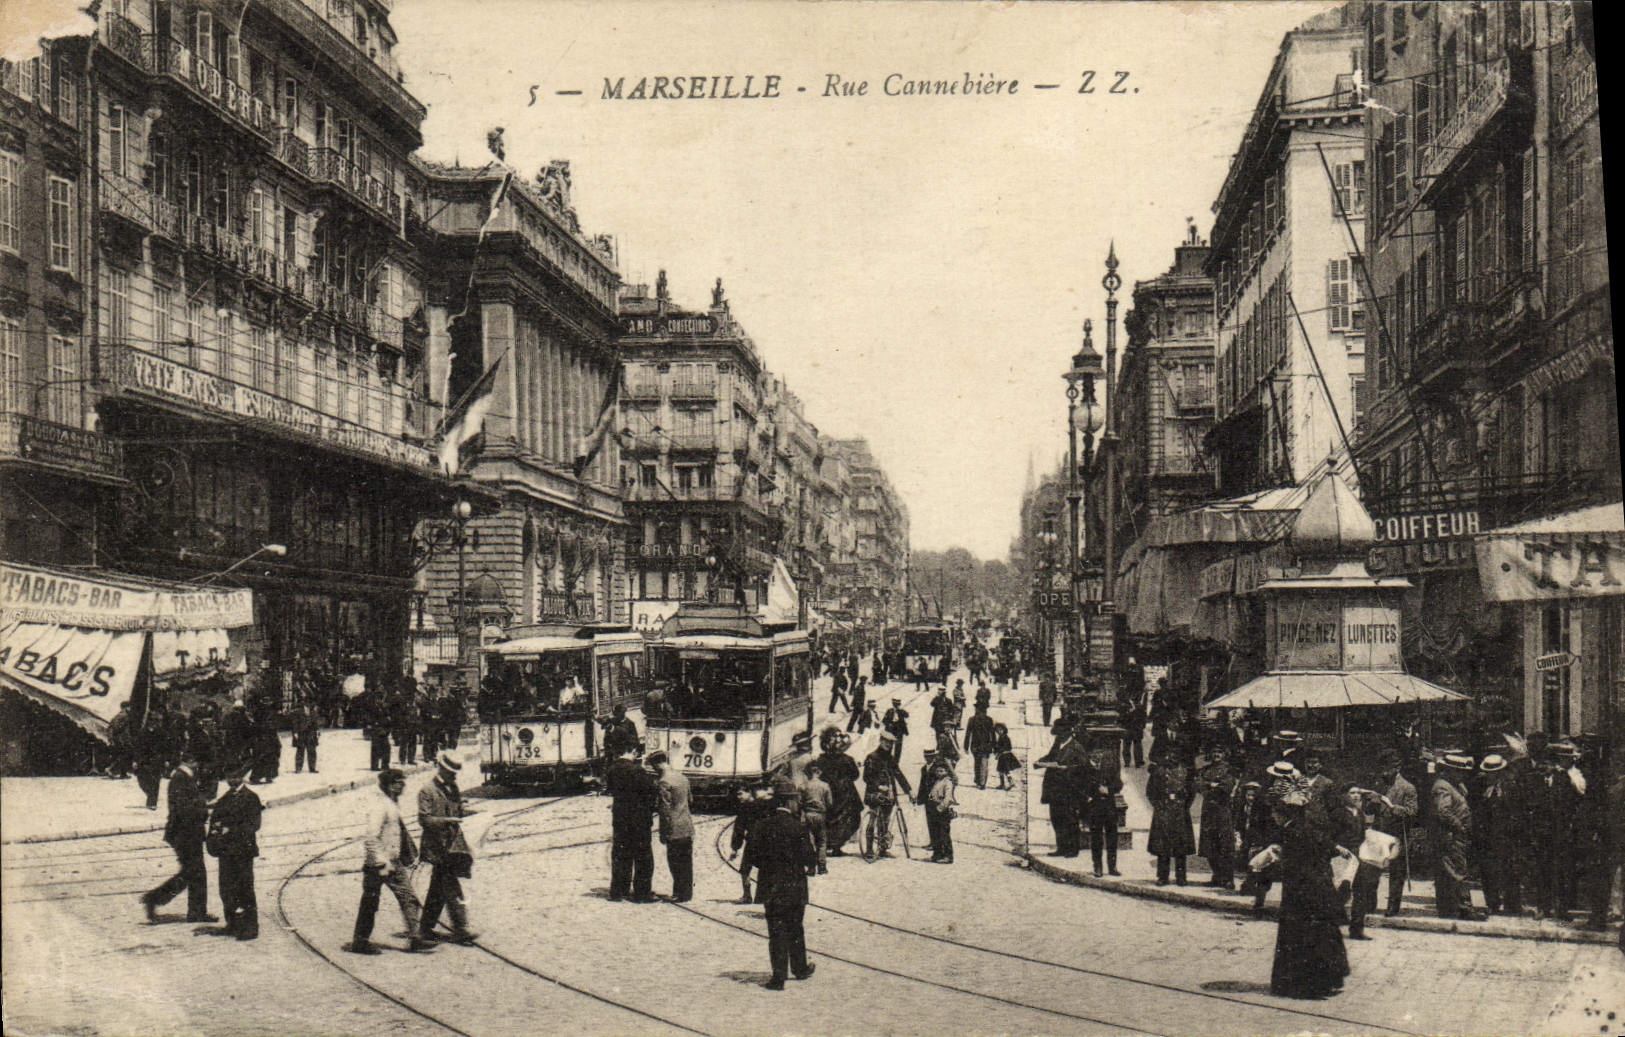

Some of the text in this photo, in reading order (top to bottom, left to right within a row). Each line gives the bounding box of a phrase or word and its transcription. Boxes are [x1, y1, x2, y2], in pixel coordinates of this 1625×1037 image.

[1372, 512, 1481, 542] COIFFEUR
[1280, 622, 1398, 645] PINCE-NEZ LUNETTES
[515, 746, 541, 759] 732
[683, 754, 714, 769] 708
